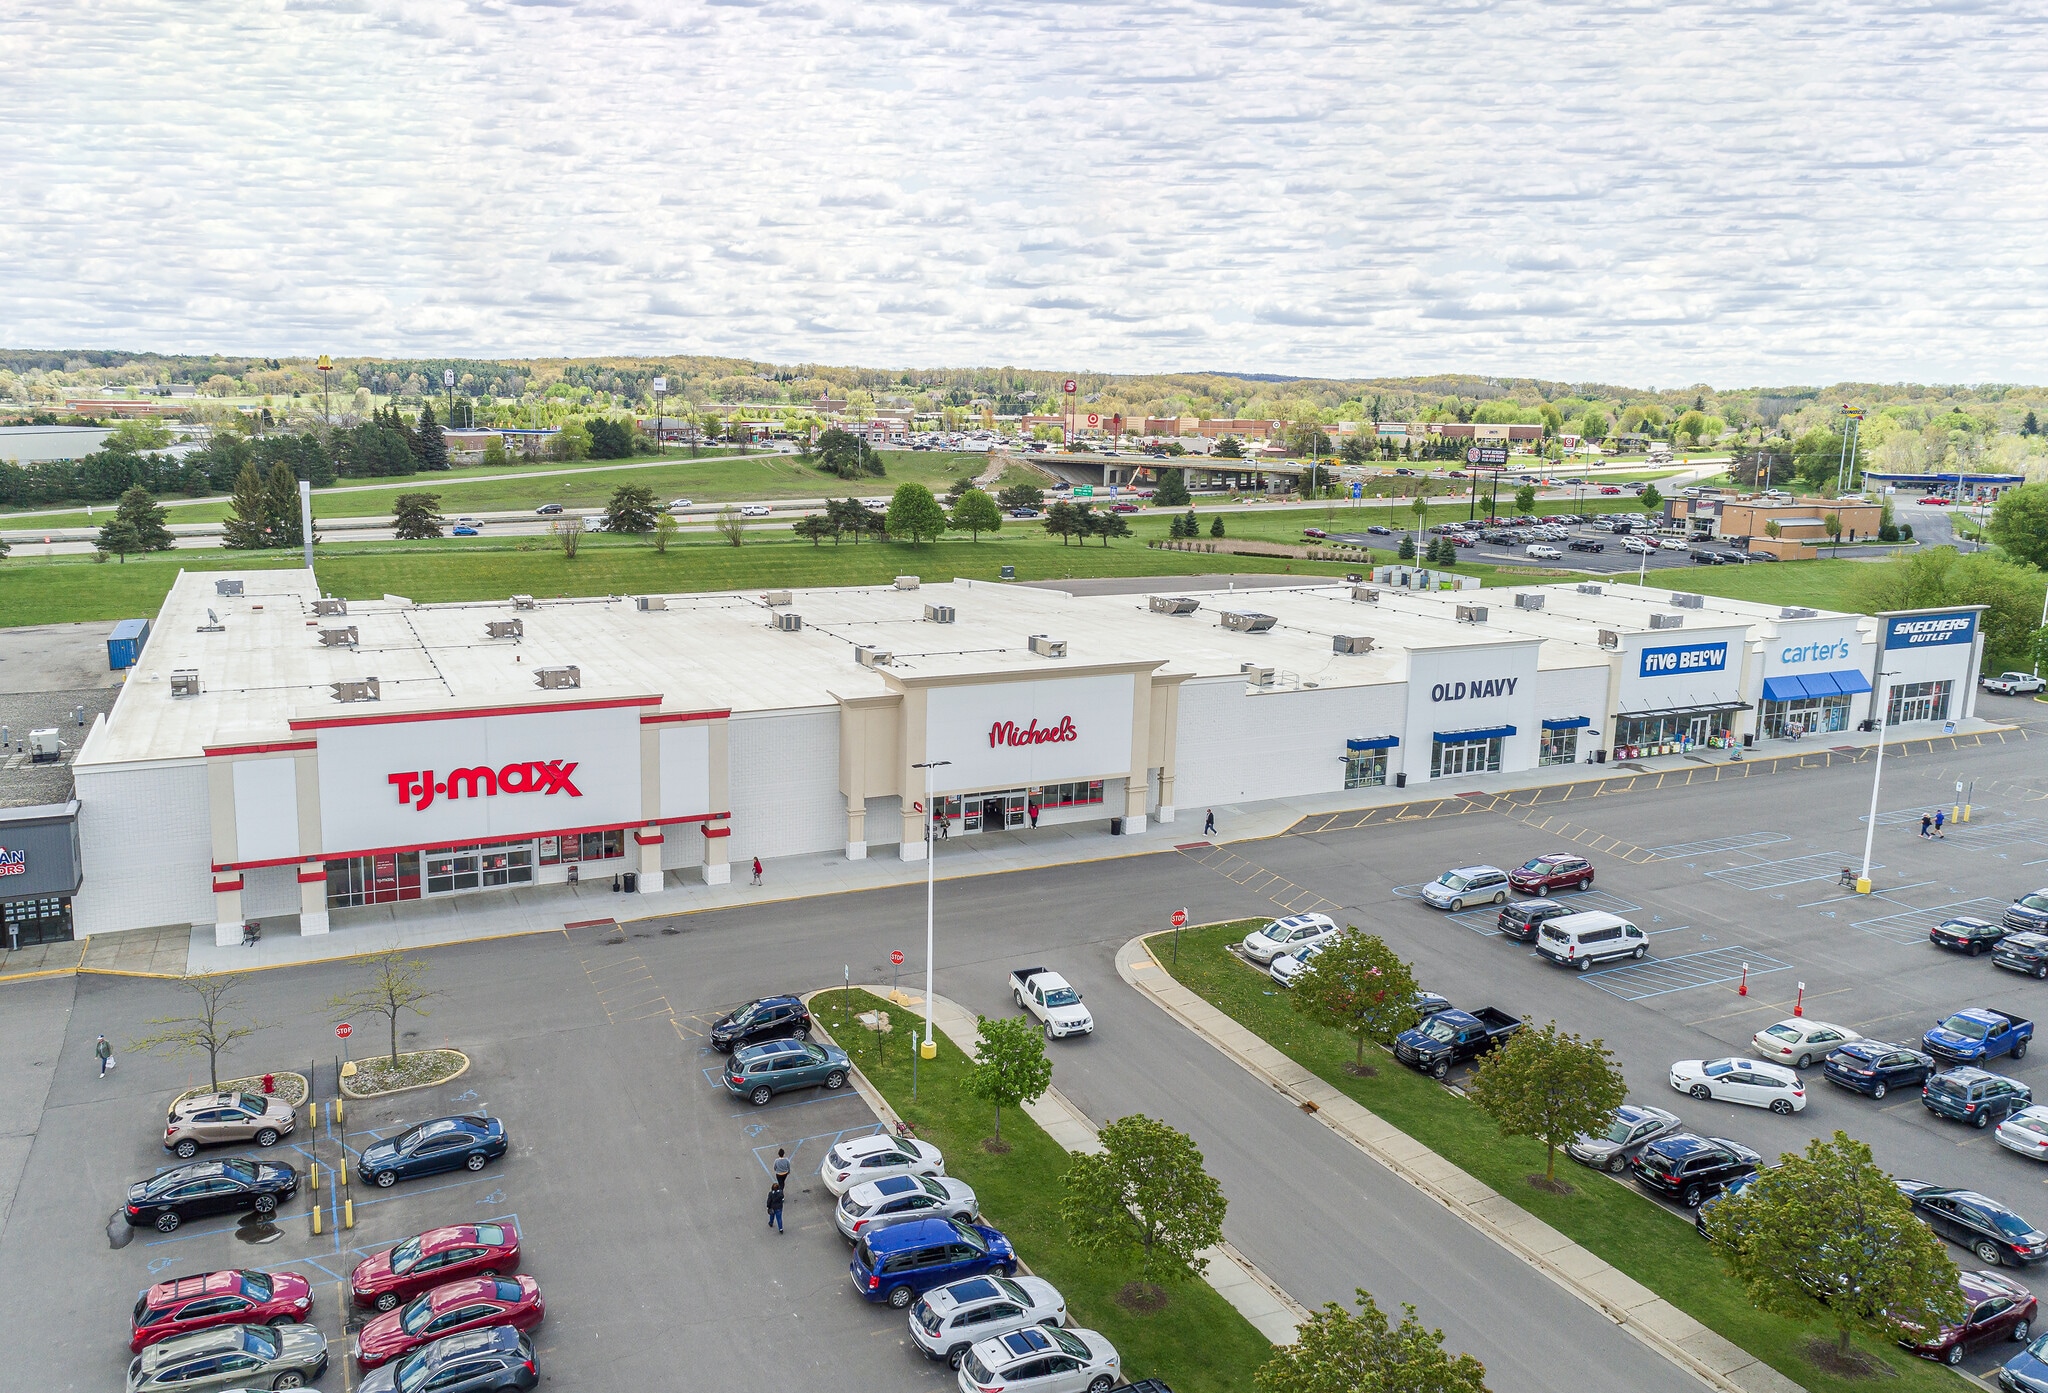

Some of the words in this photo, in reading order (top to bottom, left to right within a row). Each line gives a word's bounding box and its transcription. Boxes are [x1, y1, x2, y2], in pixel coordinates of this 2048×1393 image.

[1893, 618, 1970, 635] SKECHERS
[1909, 632, 1952, 643] OUTLET
[1781, 637, 1849, 664] carter's
[1645, 653, 1677, 671] five
[1431, 682, 1466, 702] OLD
[1470, 677, 1518, 699] NAVY
[988, 715, 1077, 748] Michaels
